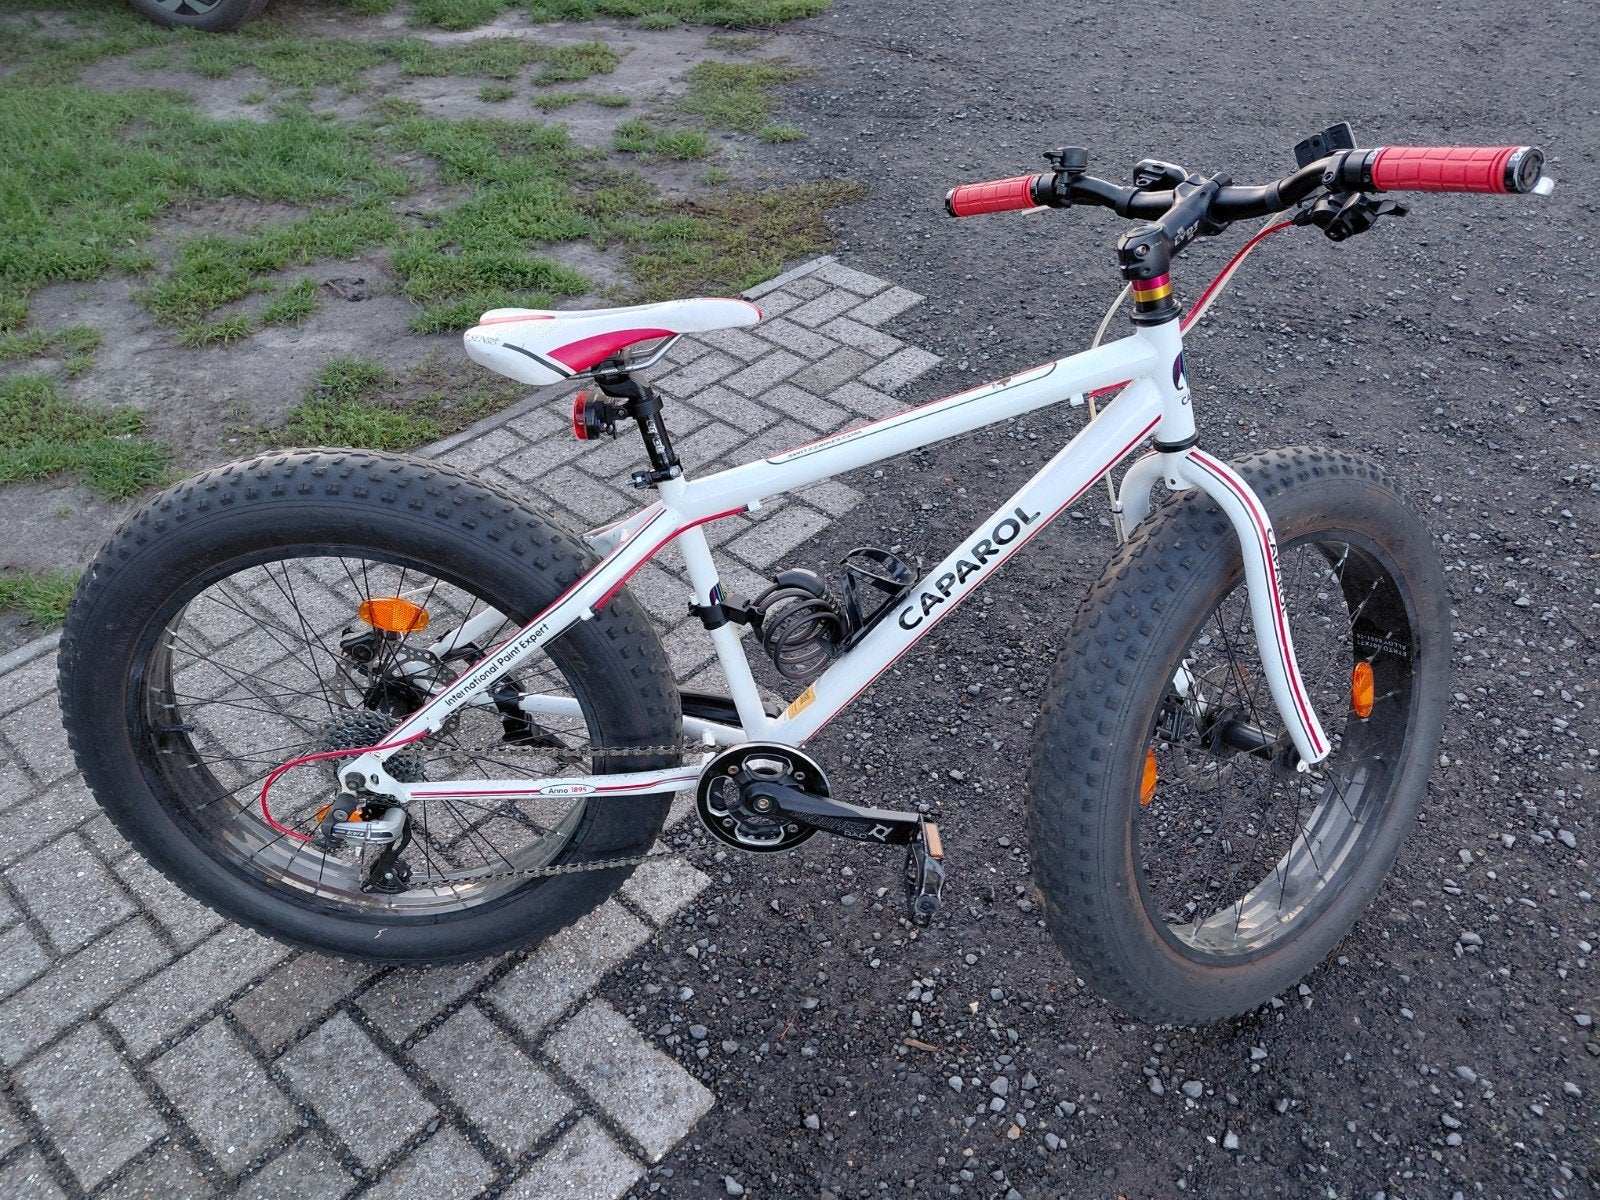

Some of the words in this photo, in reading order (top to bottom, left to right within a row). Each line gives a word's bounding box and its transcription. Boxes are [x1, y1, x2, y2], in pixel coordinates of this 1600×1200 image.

[898, 507, 1041, 631] CAPAROL
[444, 662, 500, 707] International
[497, 646, 522, 666] Paint
[519, 623, 550, 649] Expert
